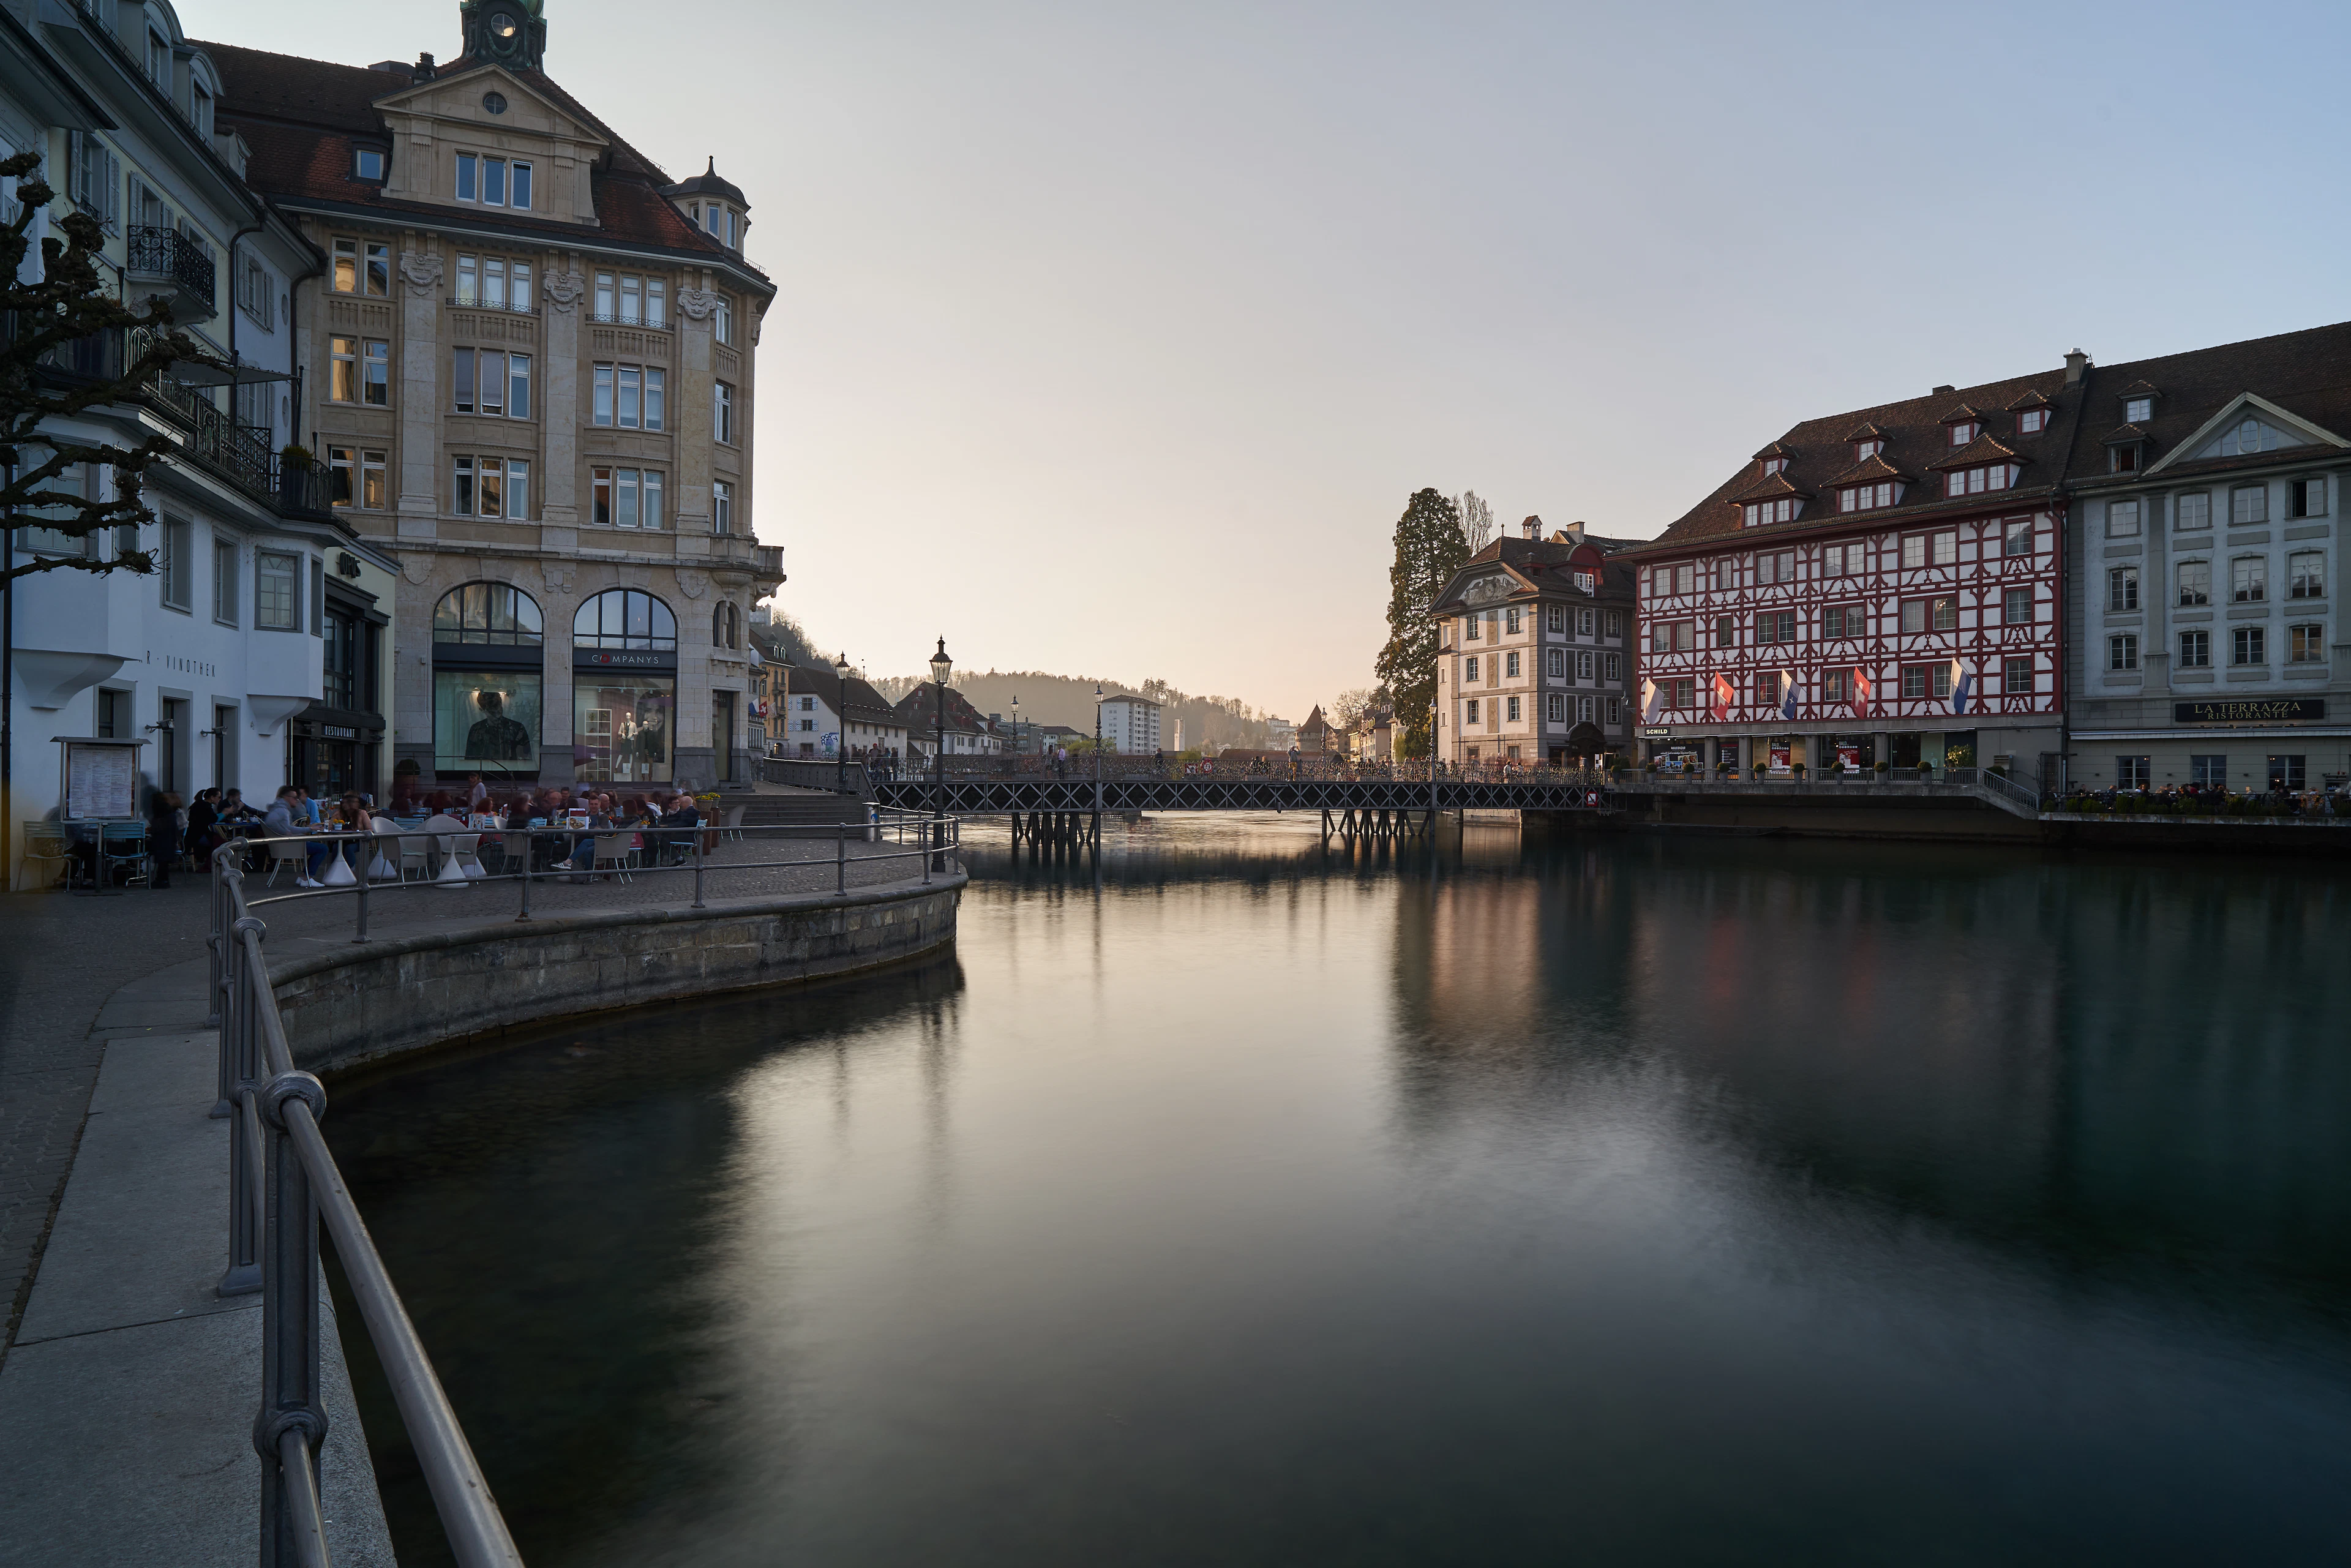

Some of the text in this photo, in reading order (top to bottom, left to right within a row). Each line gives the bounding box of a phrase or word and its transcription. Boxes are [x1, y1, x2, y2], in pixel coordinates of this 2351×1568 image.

[339, 552, 361, 579] OPUS
[167, 655, 215, 677] VINOTHEK
[2194, 702, 2301, 713] LA TERRAZZA
[2207, 711, 2289, 719] RISTORANTE
[324, 725, 355, 738] RESTAURANT
